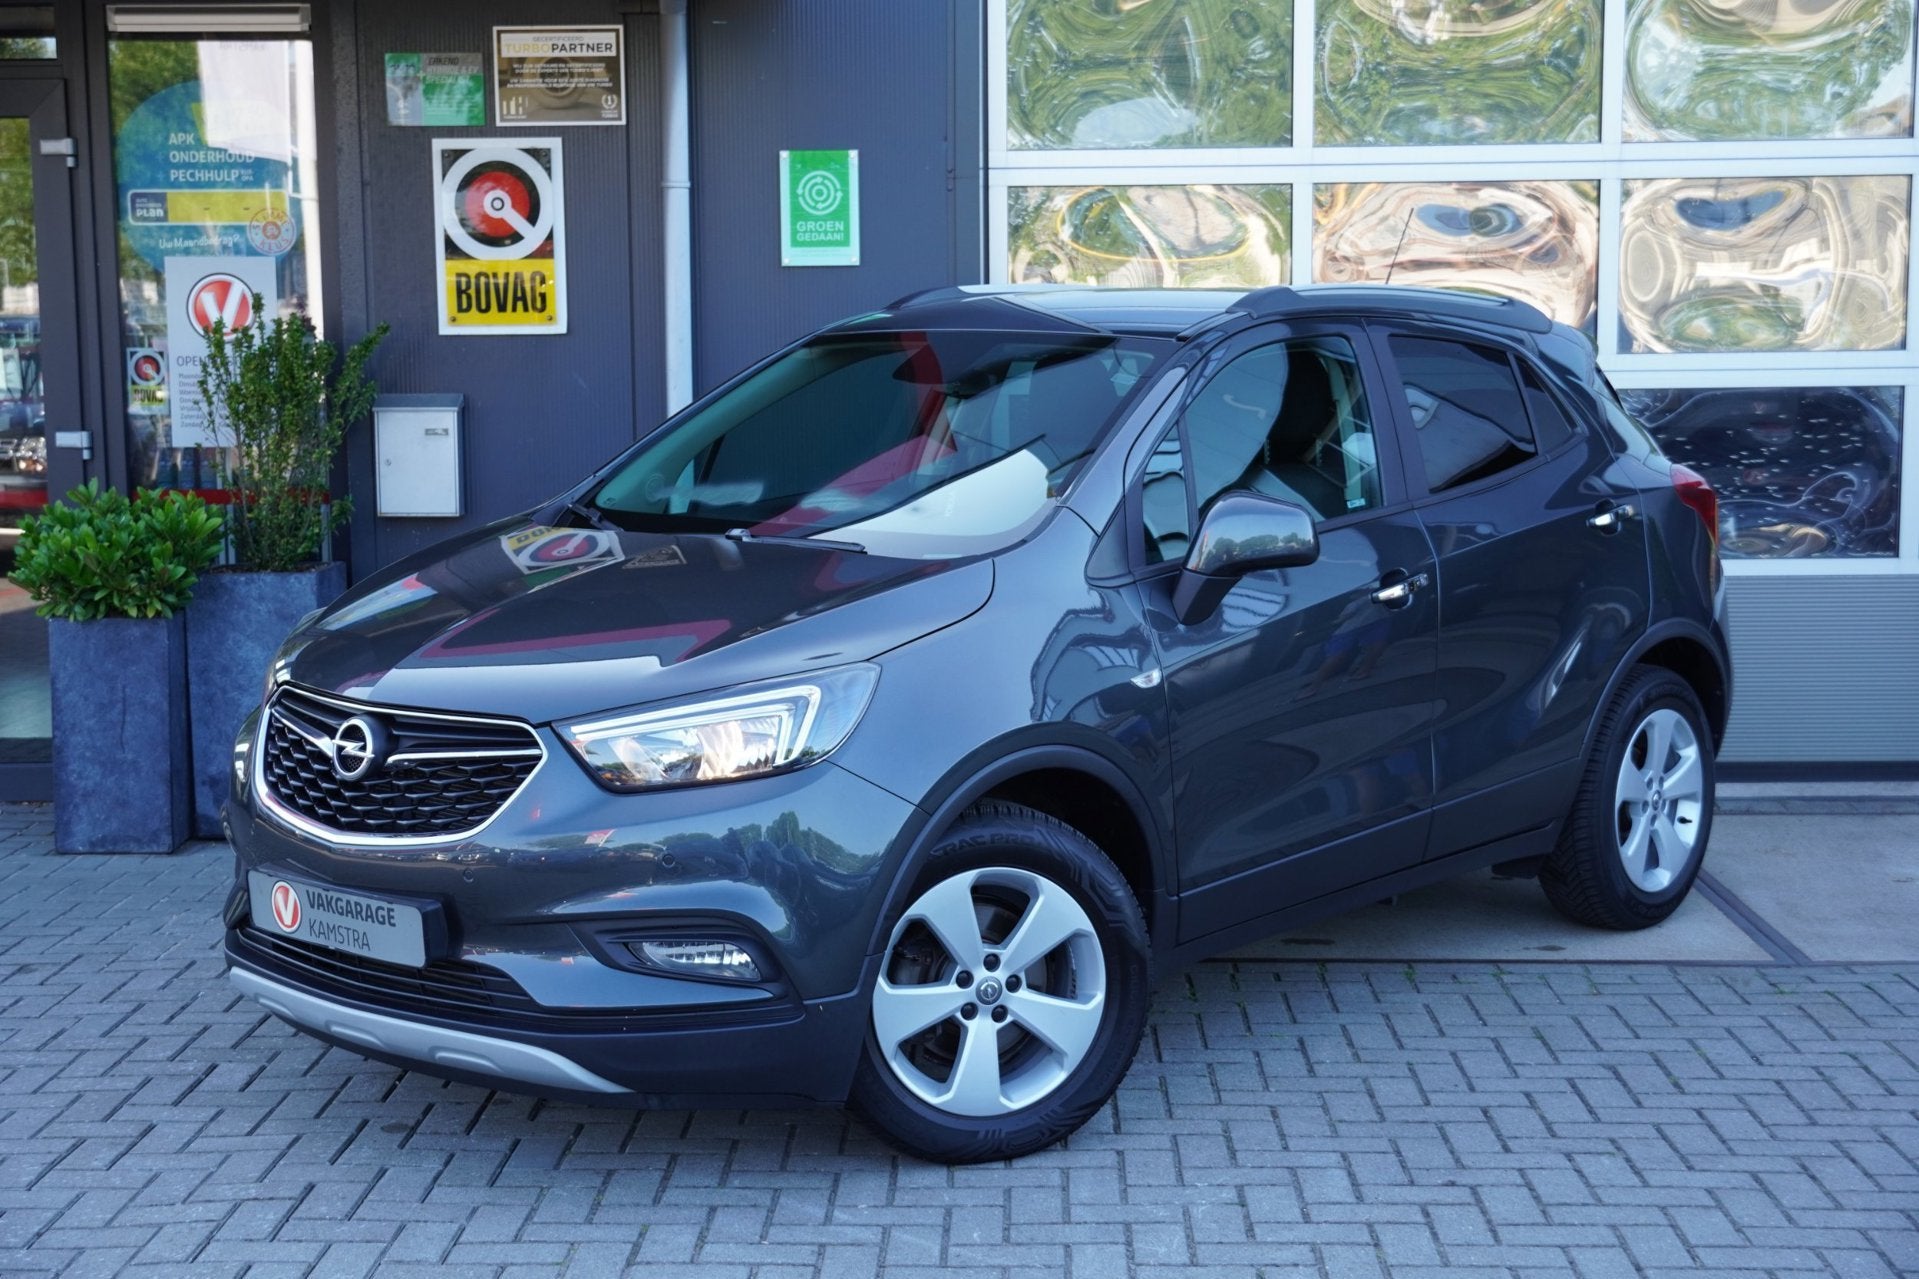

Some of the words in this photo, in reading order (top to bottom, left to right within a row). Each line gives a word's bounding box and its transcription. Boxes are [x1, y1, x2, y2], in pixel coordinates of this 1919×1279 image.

[504, 43, 613, 54] TURBOPARTNER
[168, 132, 195, 145] APK
[169, 150, 255, 163] ONDERHOUD
[170, 169, 239, 182] PECHHULP
[796, 221, 844, 232] GROEN
[796, 232, 844, 241] GEDAAN!
[455, 271, 547, 314] BOVAG
[305, 889, 397, 927] VAKGARAGE
[308, 918, 371, 951] KAMSTRA
